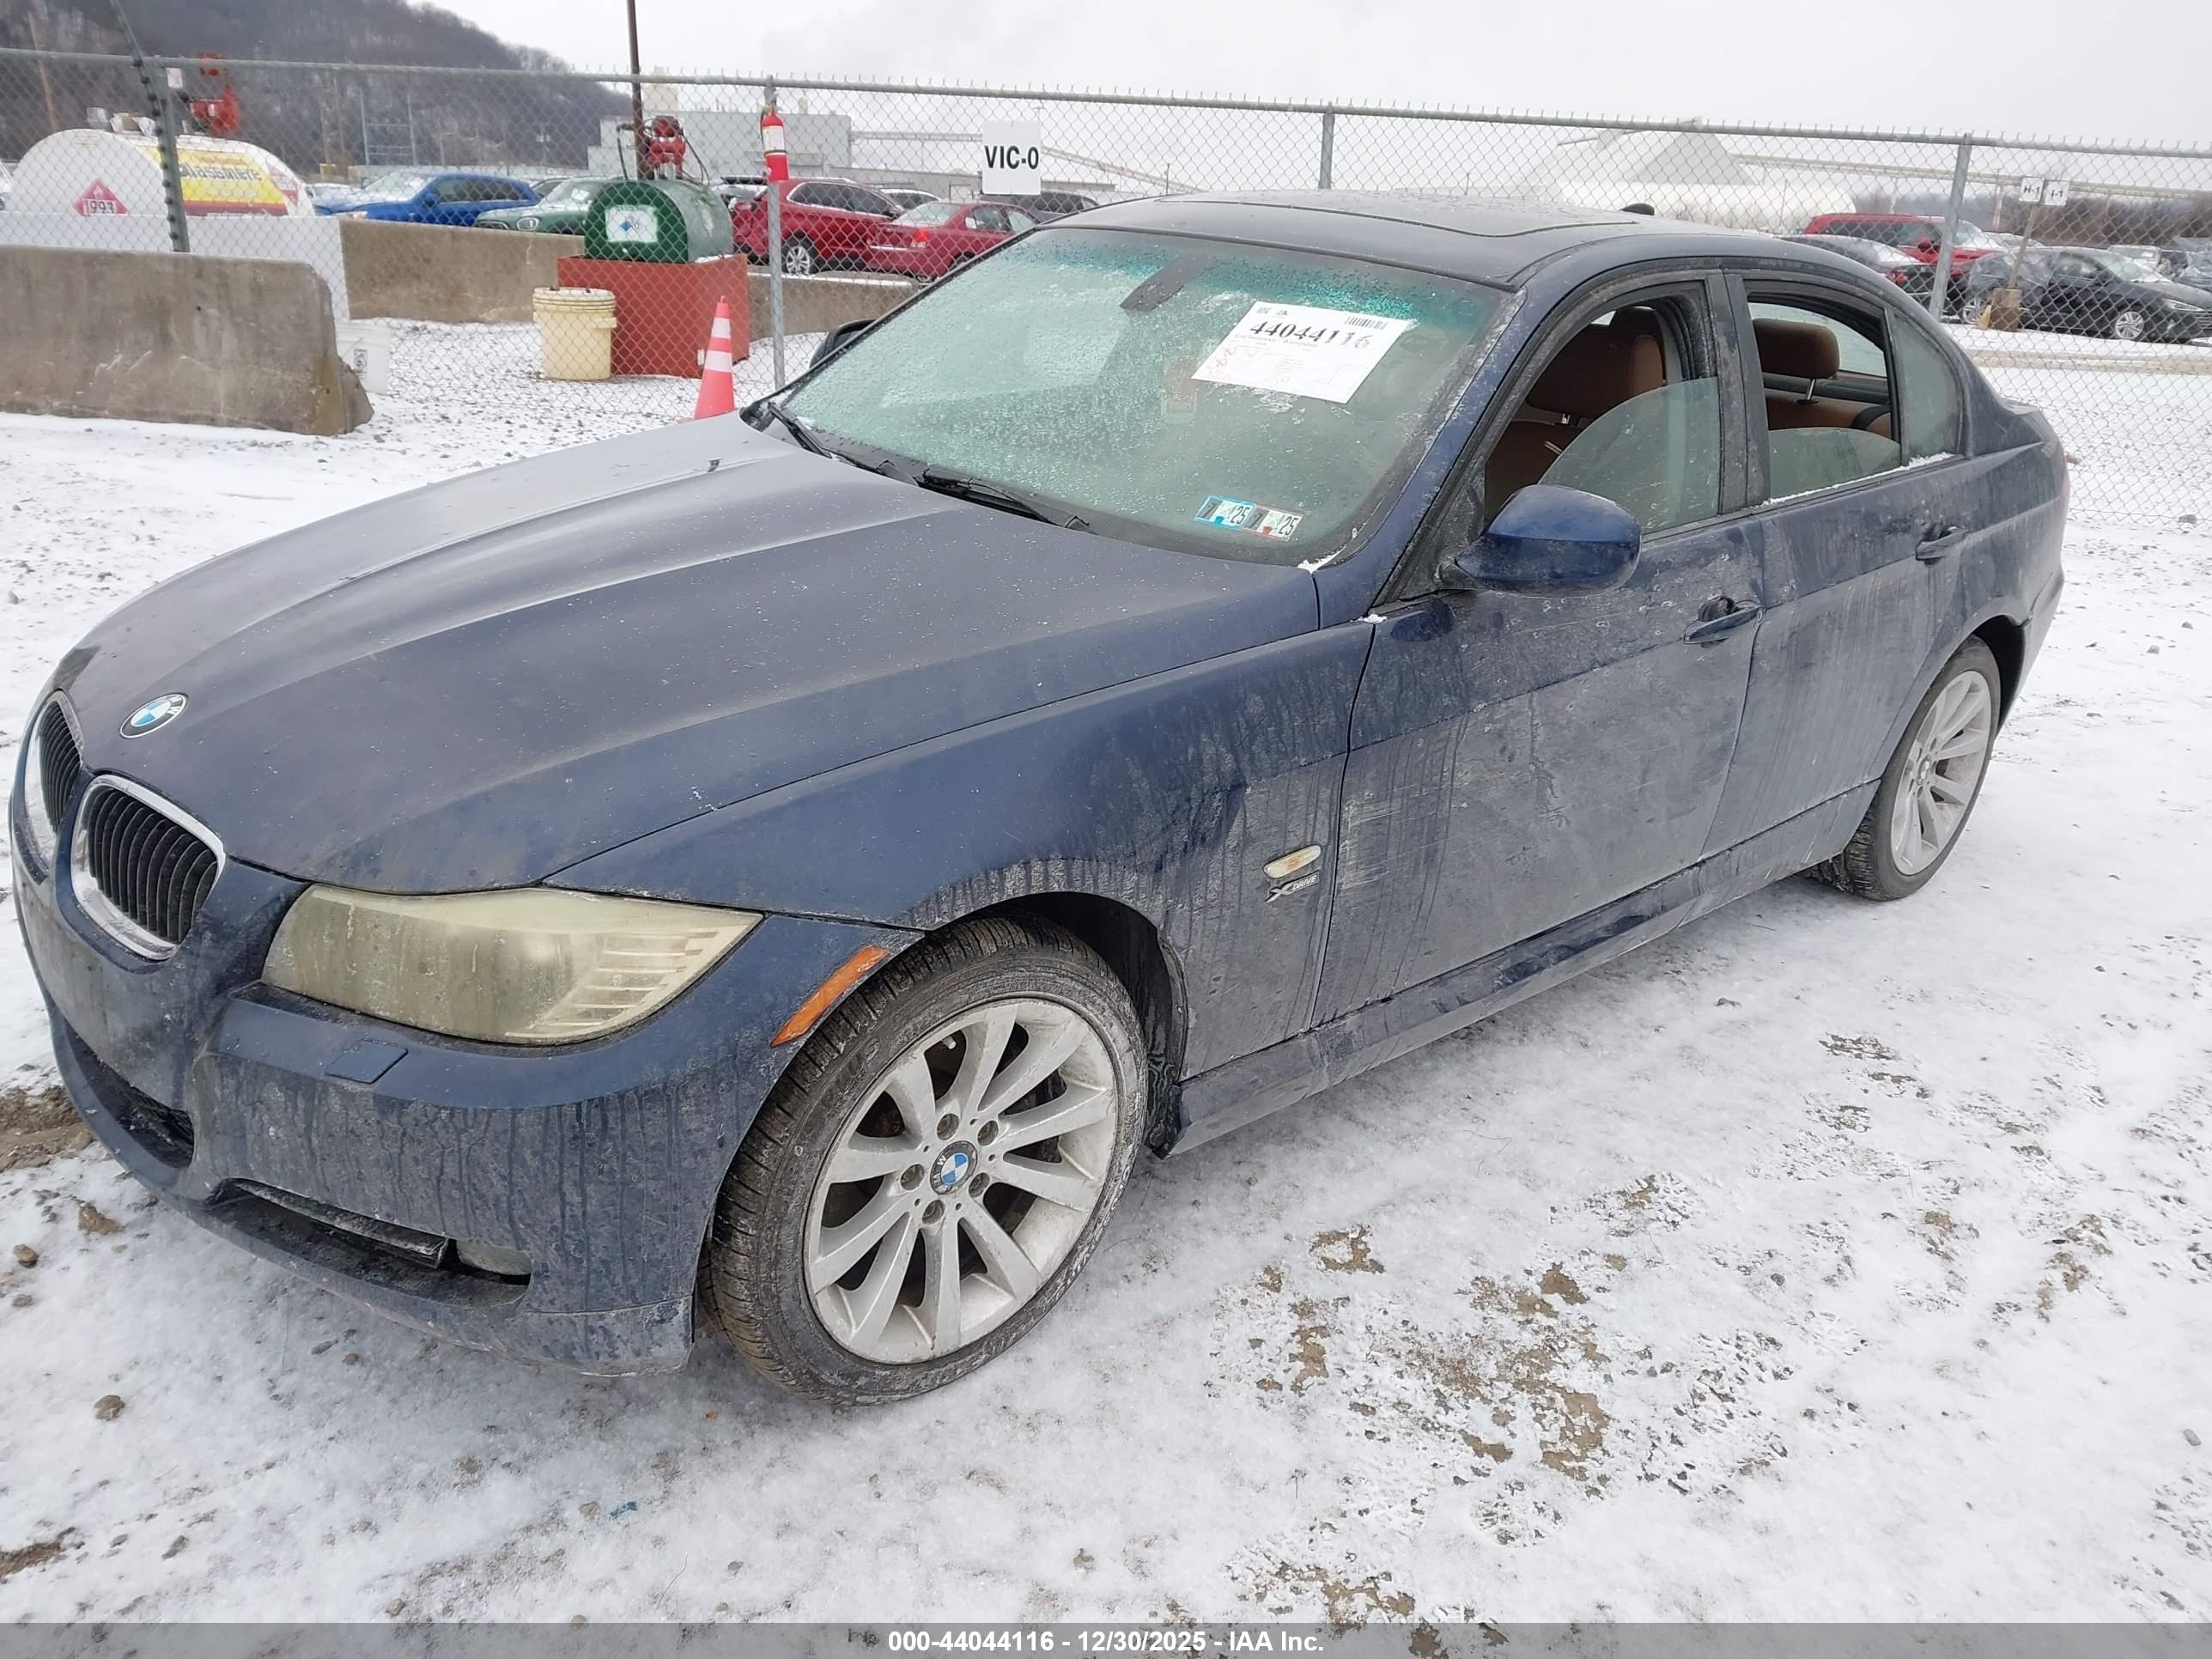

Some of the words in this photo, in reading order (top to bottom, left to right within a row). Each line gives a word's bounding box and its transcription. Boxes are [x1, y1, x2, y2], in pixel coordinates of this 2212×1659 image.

[984, 145, 1039, 170] VIC-0
[1249, 321, 1372, 349] 44044116
[1231, 505, 1250, 525] 25
[1278, 515, 1298, 537] 25
